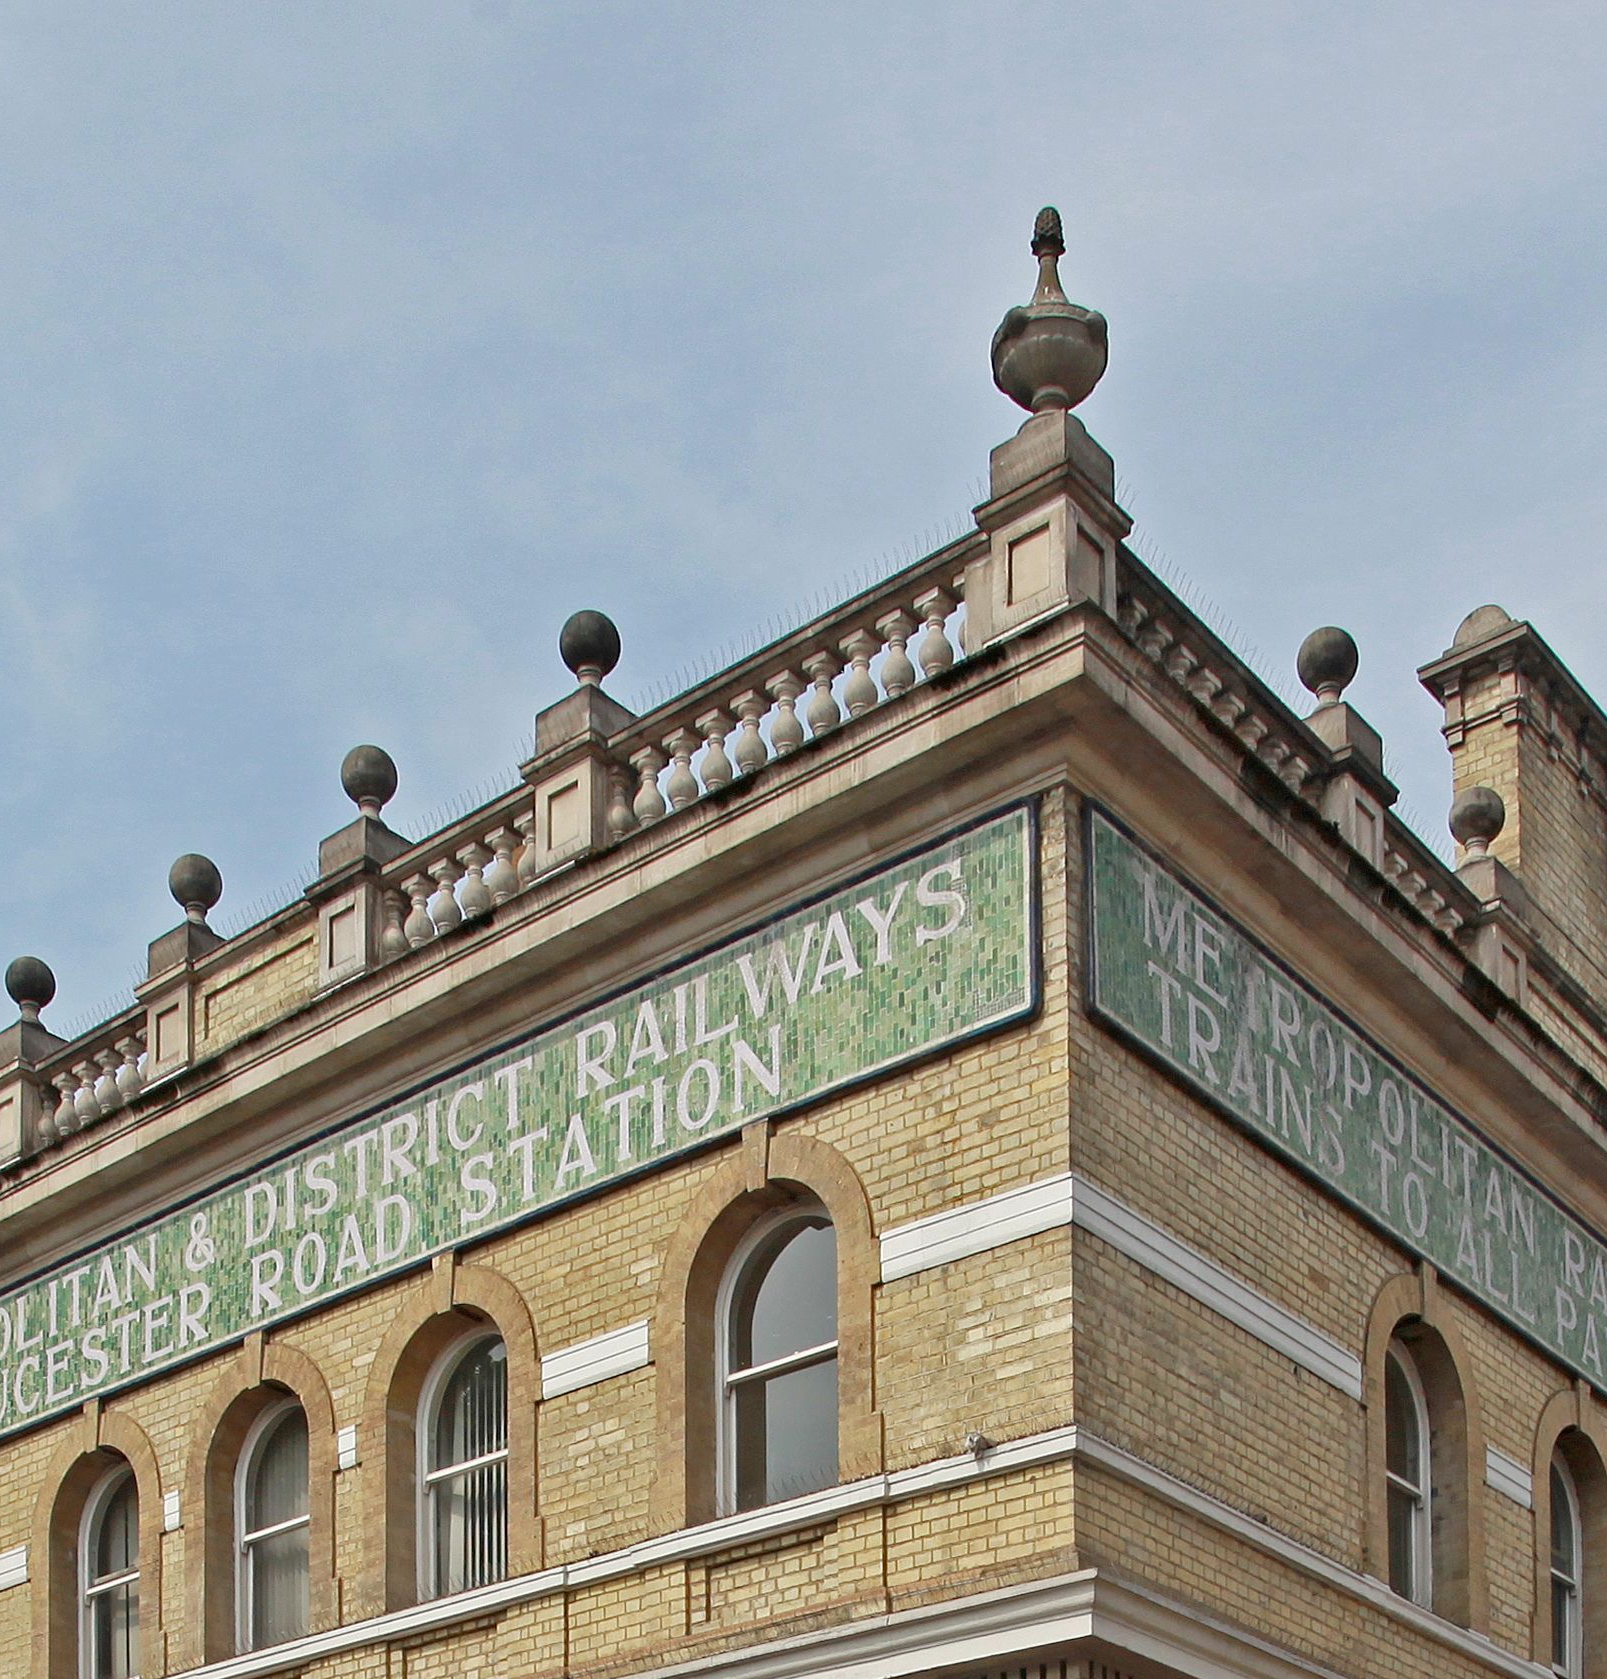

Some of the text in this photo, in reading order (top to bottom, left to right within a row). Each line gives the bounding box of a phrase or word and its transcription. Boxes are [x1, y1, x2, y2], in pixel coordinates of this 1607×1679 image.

[184, 1211, 215, 1272] &
[244, 1055, 536, 1249] DISTRICT
[575, 857, 967, 1100] RAILWAYS
[249, 1193, 412, 1317] ROAD
[461, 1024, 783, 1226] STATION
[1136, 867, 1537, 1257] METROPOLITAN
[1147, 960, 1345, 1176] TRAINS
[1371, 1139, 1429, 1239] TO
[1456, 1217, 1536, 1326] ALL
